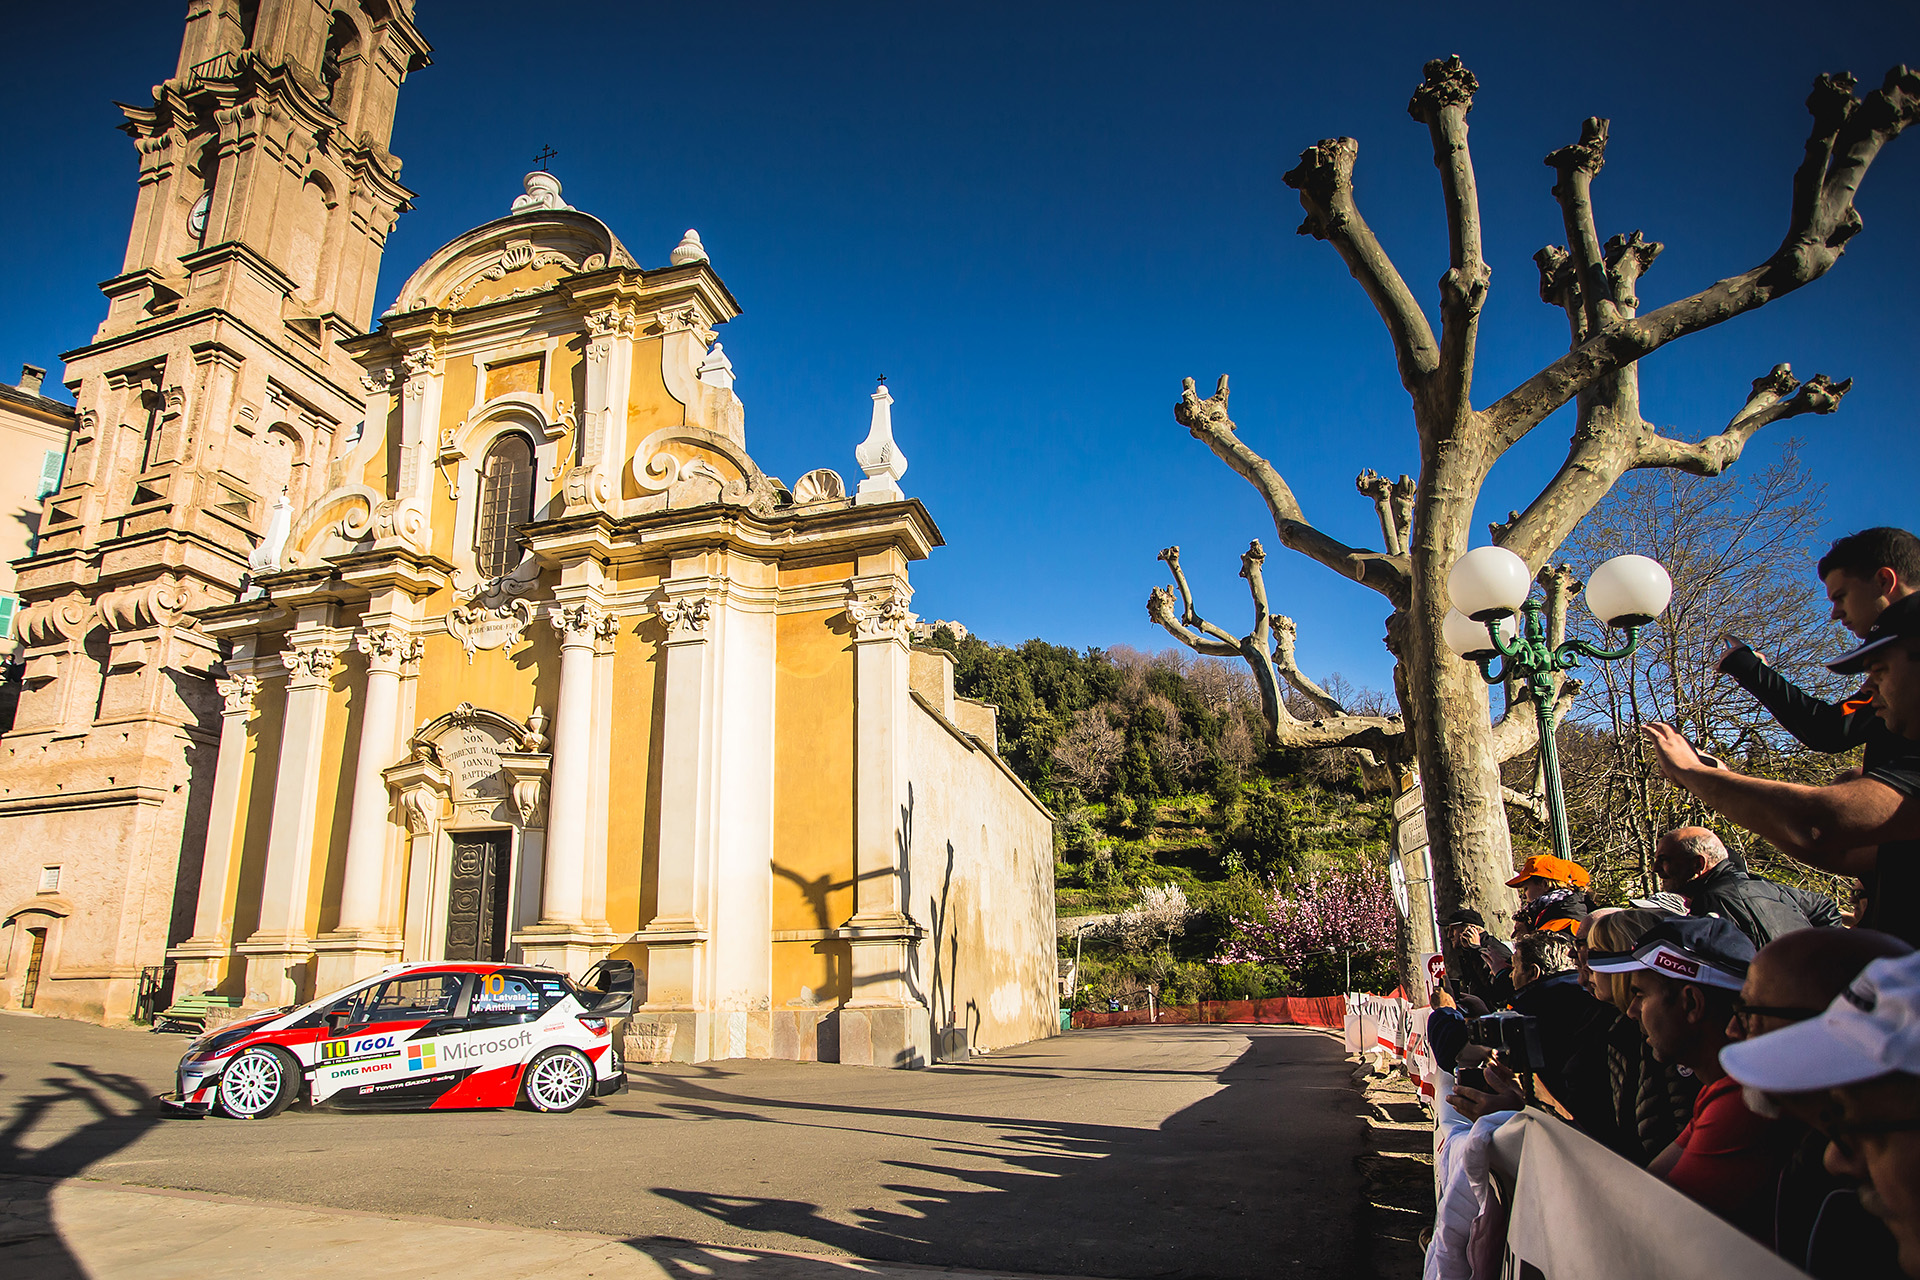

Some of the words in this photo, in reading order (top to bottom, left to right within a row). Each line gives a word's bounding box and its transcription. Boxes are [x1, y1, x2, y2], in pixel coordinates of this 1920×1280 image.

[463, 735, 484, 744] NON
[461, 770, 498, 781] BAPTISTA
[1658, 954, 1696, 975] TOTAL
[481, 974, 505, 995] 10
[472, 994, 491, 1002] J.M.
[493, 993, 527, 1002] Latvala
[472, 1003, 483, 1012] M.
[485, 1003, 516, 1011] Anttila
[325, 1041, 346, 1059] 10
[354, 1036, 395, 1053] IGOL
[443, 1030, 532, 1061] Microsoft
[331, 1068, 359, 1079] DMG
[361, 1063, 393, 1074] MORI
[375, 1082, 404, 1092] TOYOTA
[404, 1078, 431, 1087] GAZOO
[430, 1074, 456, 1083] Racing
